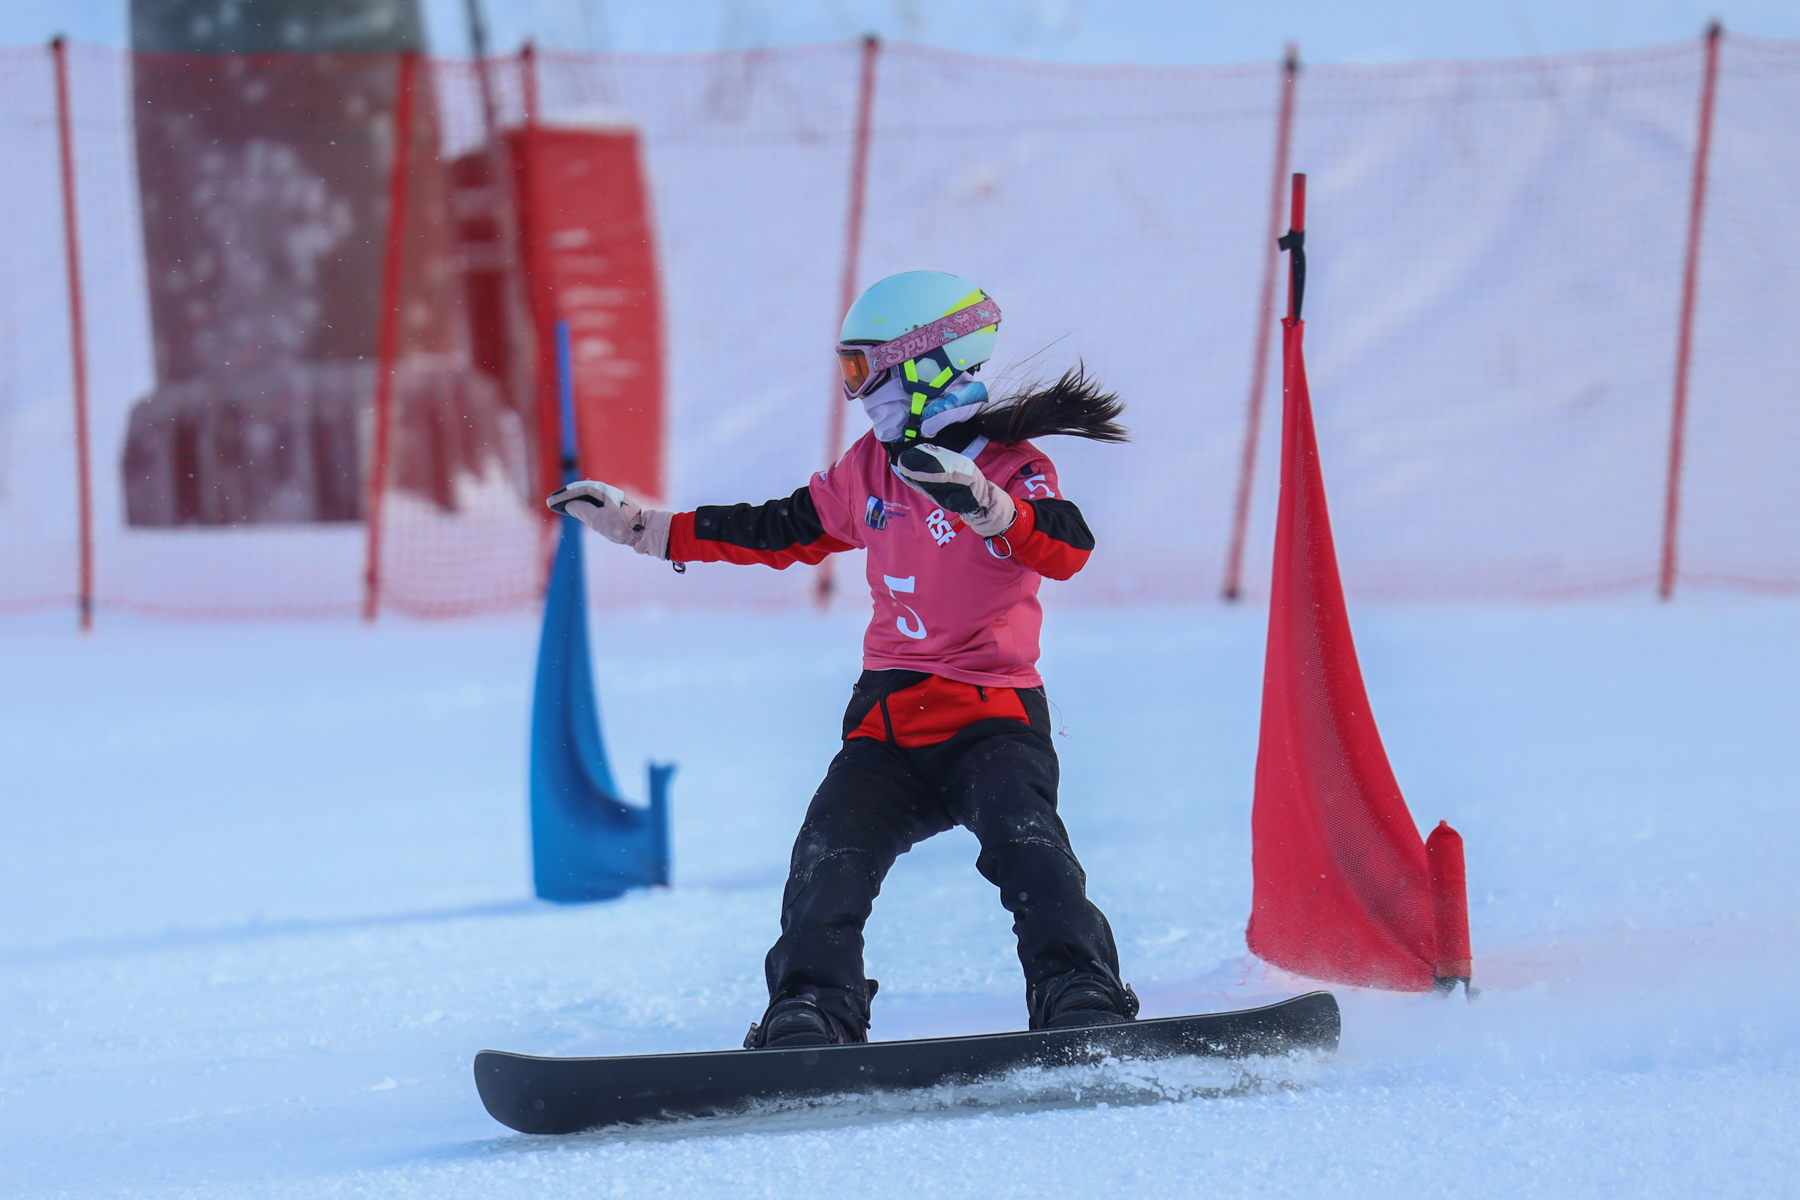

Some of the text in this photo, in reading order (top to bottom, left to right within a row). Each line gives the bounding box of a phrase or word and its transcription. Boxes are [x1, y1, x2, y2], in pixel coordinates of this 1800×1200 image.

[1024, 474, 1056, 499] 5
[925, 508, 957, 547] RSF
[883, 574, 928, 640] 5
